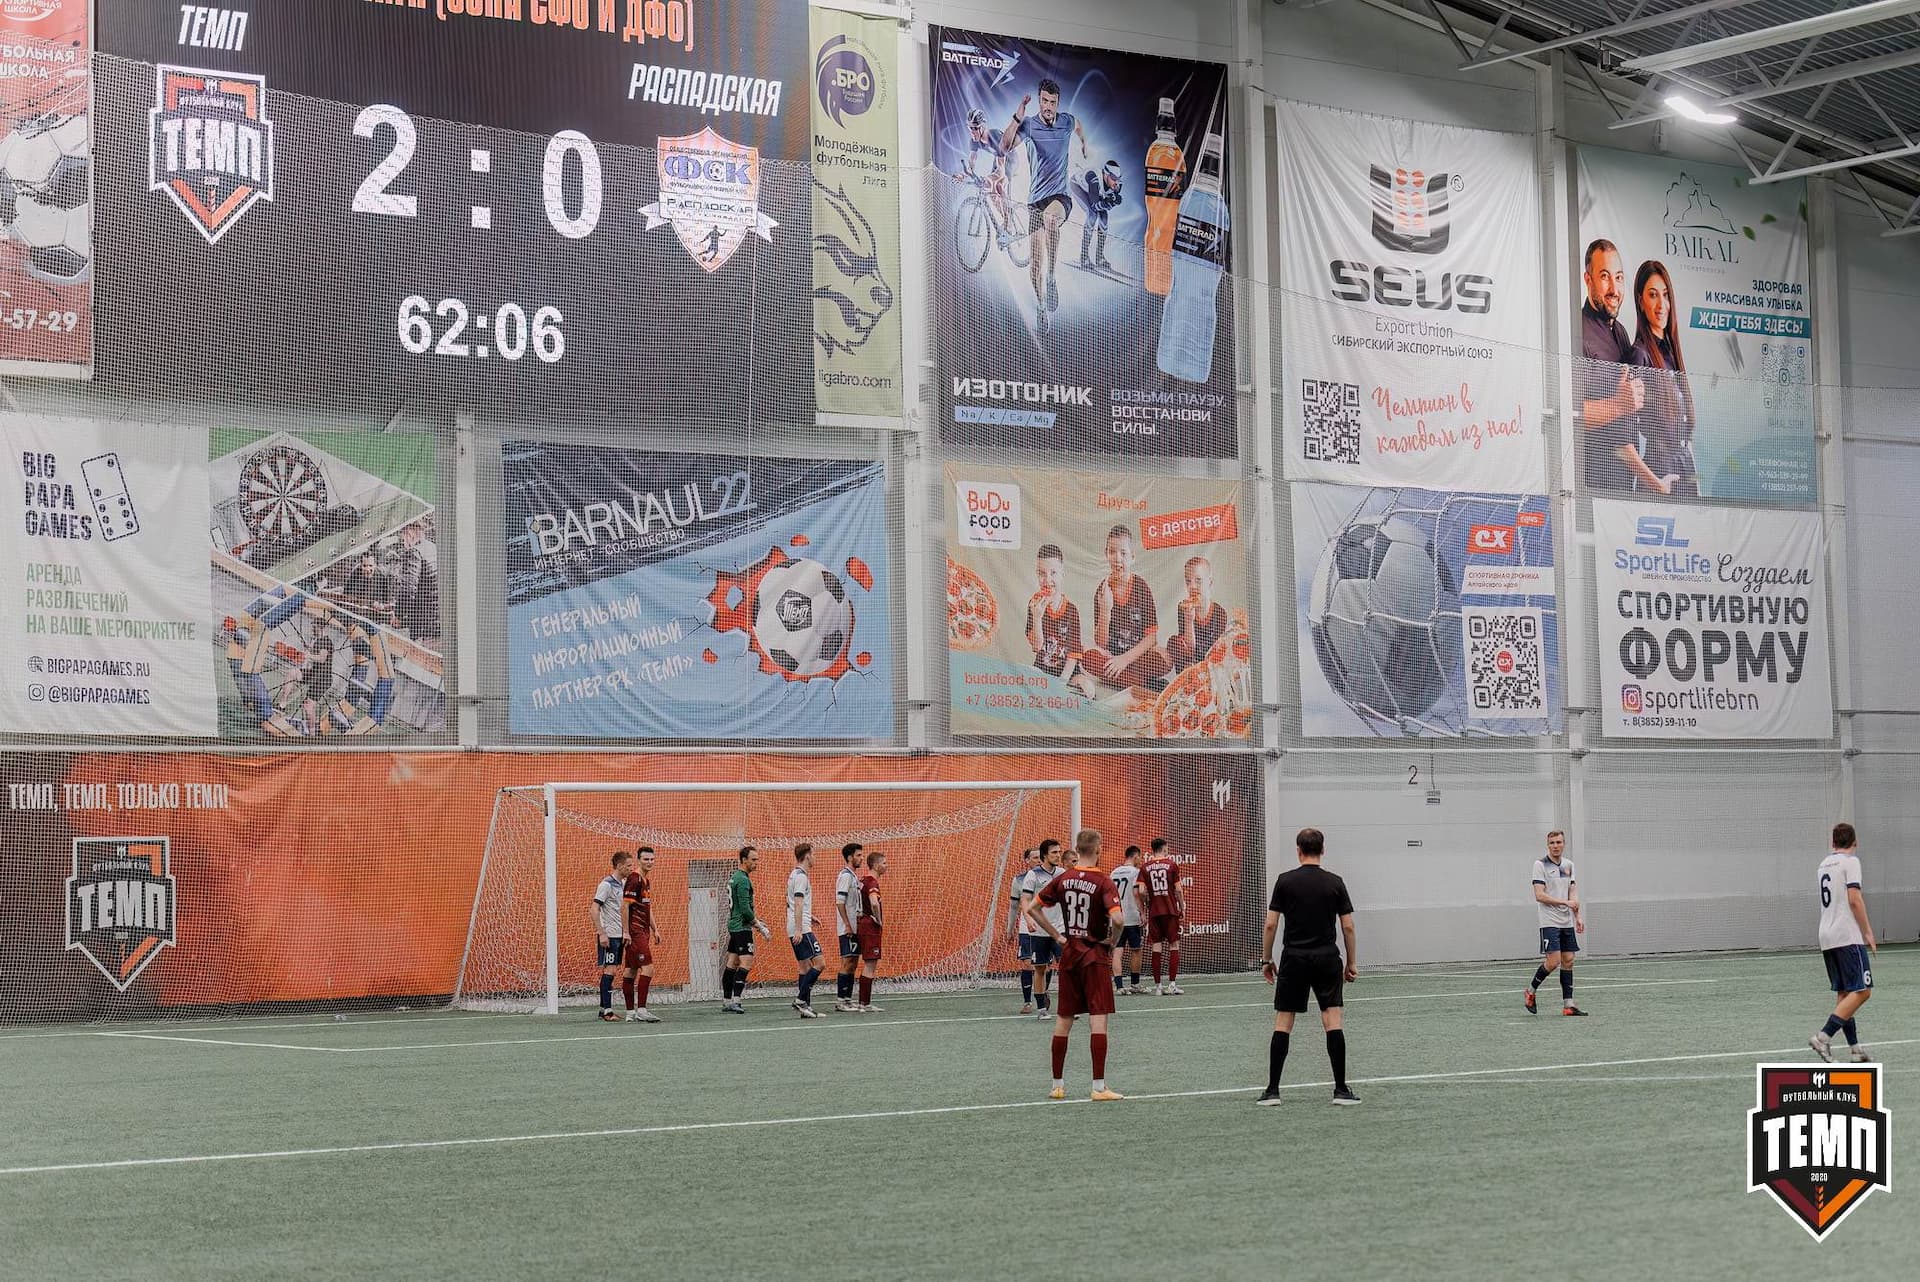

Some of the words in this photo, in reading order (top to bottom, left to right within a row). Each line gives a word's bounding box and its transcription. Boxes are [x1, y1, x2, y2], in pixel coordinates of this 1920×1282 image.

[180, 4, 249, 52] ТЕМП
[530, 0, 589, 30] СФО
[599, 0, 616, 33] И
[623, 0, 695, 52] ДФО)
[0, 45, 75, 62] БОЛЬНАЯ
[628, 63, 782, 117] РАСПАДСКАЯ
[162, 118, 261, 182] ТЕМП
[814, 135, 887, 157] Молодёжная
[352, 104, 417, 217] 2
[543, 129, 603, 239] 0
[664, 156, 753, 184] ФСК
[816, 152, 887, 172] футбольная
[862, 174, 887, 188] лига
[1665, 233, 1740, 264] BAIKAL
[1330, 260, 1494, 314] SEUS
[1752, 279, 1803, 295] ЗДОРОВАЯ
[1705, 290, 1712, 302] И
[1714, 291, 1764, 308] КРАСИВАЯ
[1766, 298, 1803, 311] УЛЫБКА
[0, 308, 78, 332] -57-29
[398, 296, 566, 363] 62:06
[1376, 317, 1415, 337] Export
[1420, 320, 1453, 339] Union
[1698, 311, 1733, 328] ЖДЕТ
[1735, 314, 1762, 330] ТЕБЯ
[1764, 317, 1803, 335] ЗДЕСЬ!
[1331, 333, 1394, 351] СИБИРСКИЙ
[1397, 340, 1465, 358] ЭКСПОРТНЫЙ
[1467, 348, 1493, 359] СОЮЗ
[818, 368, 892, 390] ligabro.com
[953, 377, 1093, 406] ИЗОТОНИК
[1111, 389, 1174, 404] ВОЗЬМИ
[1371, 385, 1459, 422] Чемпион
[1461, 382, 1475, 414] в
[1112, 405, 1211, 422] ВОССТАНОВИ
[1113, 421, 1160, 435] СИЛЫ.
[1376, 419, 1458, 454] каждом
[1461, 423, 1484, 450] из
[1487, 404, 1524, 438] нас!
[23, 451, 56, 481] BIG
[25, 481, 75, 511] PAPA
[1097, 491, 1148, 511] Друзья
[25, 510, 92, 541] GAMES
[969, 514, 1011, 529] FOOD
[1162, 513, 1222, 537] детства
[1635, 516, 1690, 548] SL
[1615, 549, 1711, 574] SportLife
[1717, 553, 1814, 593] Создаем
[27, 563, 82, 587] АРЕНДА
[27, 589, 128, 613] РАЗВЛЕЧЕНИЙ
[1617, 589, 1809, 625] СПОРТИВНУЮ
[27, 614, 46, 634] НА
[51, 615, 92, 637] ВАШЕ
[96, 618, 196, 641] МЕРОПРИЯТИЕ
[531, 592, 642, 638] ГЕНЕРАЛЬНЫЙ
[532, 617, 683, 676] ИНФОРМАЦИОННЫЙ
[1619, 626, 1809, 683] ФОРМУ
[48, 658, 150, 677] BIGPAPAGAMES.RU
[964, 672, 1048, 689] budufood.org
[48, 685, 150, 704] @BIGPAPAGAMES
[532, 675, 602, 710] ПАРТНЕР
[607, 667, 633, 692] ФК
[637, 654, 694, 683] «ТЕМП»
[966, 694, 981, 706] +7
[1645, 687, 1760, 714] sportlifebrn
[1632, 717, 1663, 728] 8(3852)
[1665, 717, 1697, 727] 59-11-10
[1408, 765, 1418, 785] 2
[9, 783, 58, 812] ТЕМП,
[63, 783, 112, 812] ТЕМП,
[117, 783, 180, 810] ТОЛЬКО
[185, 783, 230, 810] ТЕМП!
[1150, 870, 1169, 891] 63
[1820, 873, 1832, 908] 6
[77, 880, 166, 932] ТЕМП
[1065, 891, 1090, 929] 33
[606, 952, 616, 963] 18
[1863, 970, 1872, 985] 6
